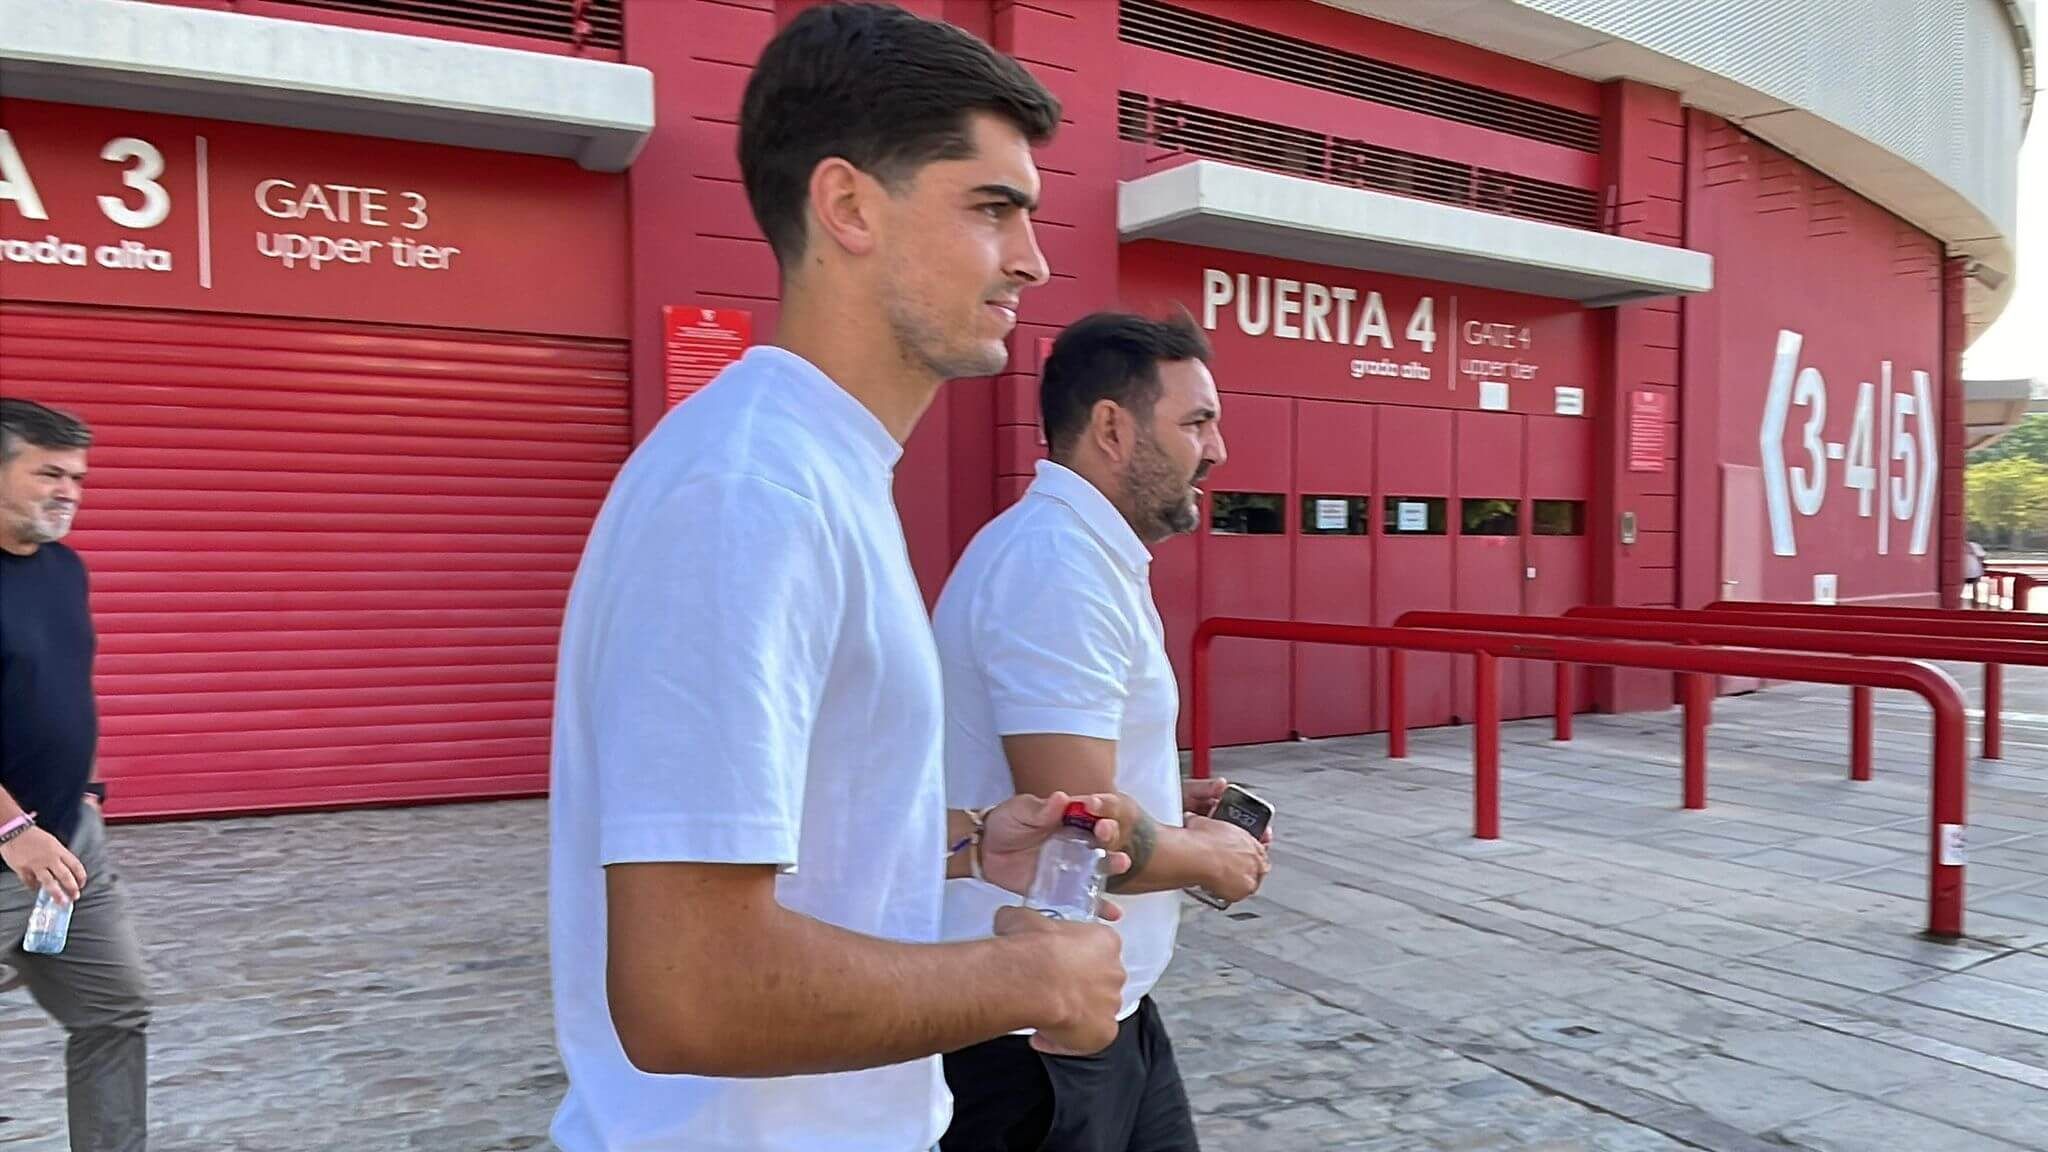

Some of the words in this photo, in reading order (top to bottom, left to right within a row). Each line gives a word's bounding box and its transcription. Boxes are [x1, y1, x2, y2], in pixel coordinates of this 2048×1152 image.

[96, 137, 171, 229] 3
[254, 178, 388, 227] GATE
[400, 191, 429, 230] 3
[95, 239, 172, 271] alta
[256, 231, 383, 270] upper
[390, 236, 461, 270] tier
[1203, 268, 1394, 349] PUERTA
[1405, 296, 1437, 353] 4
[1462, 320, 1517, 349] GATE
[1517, 326, 1532, 350] 4
